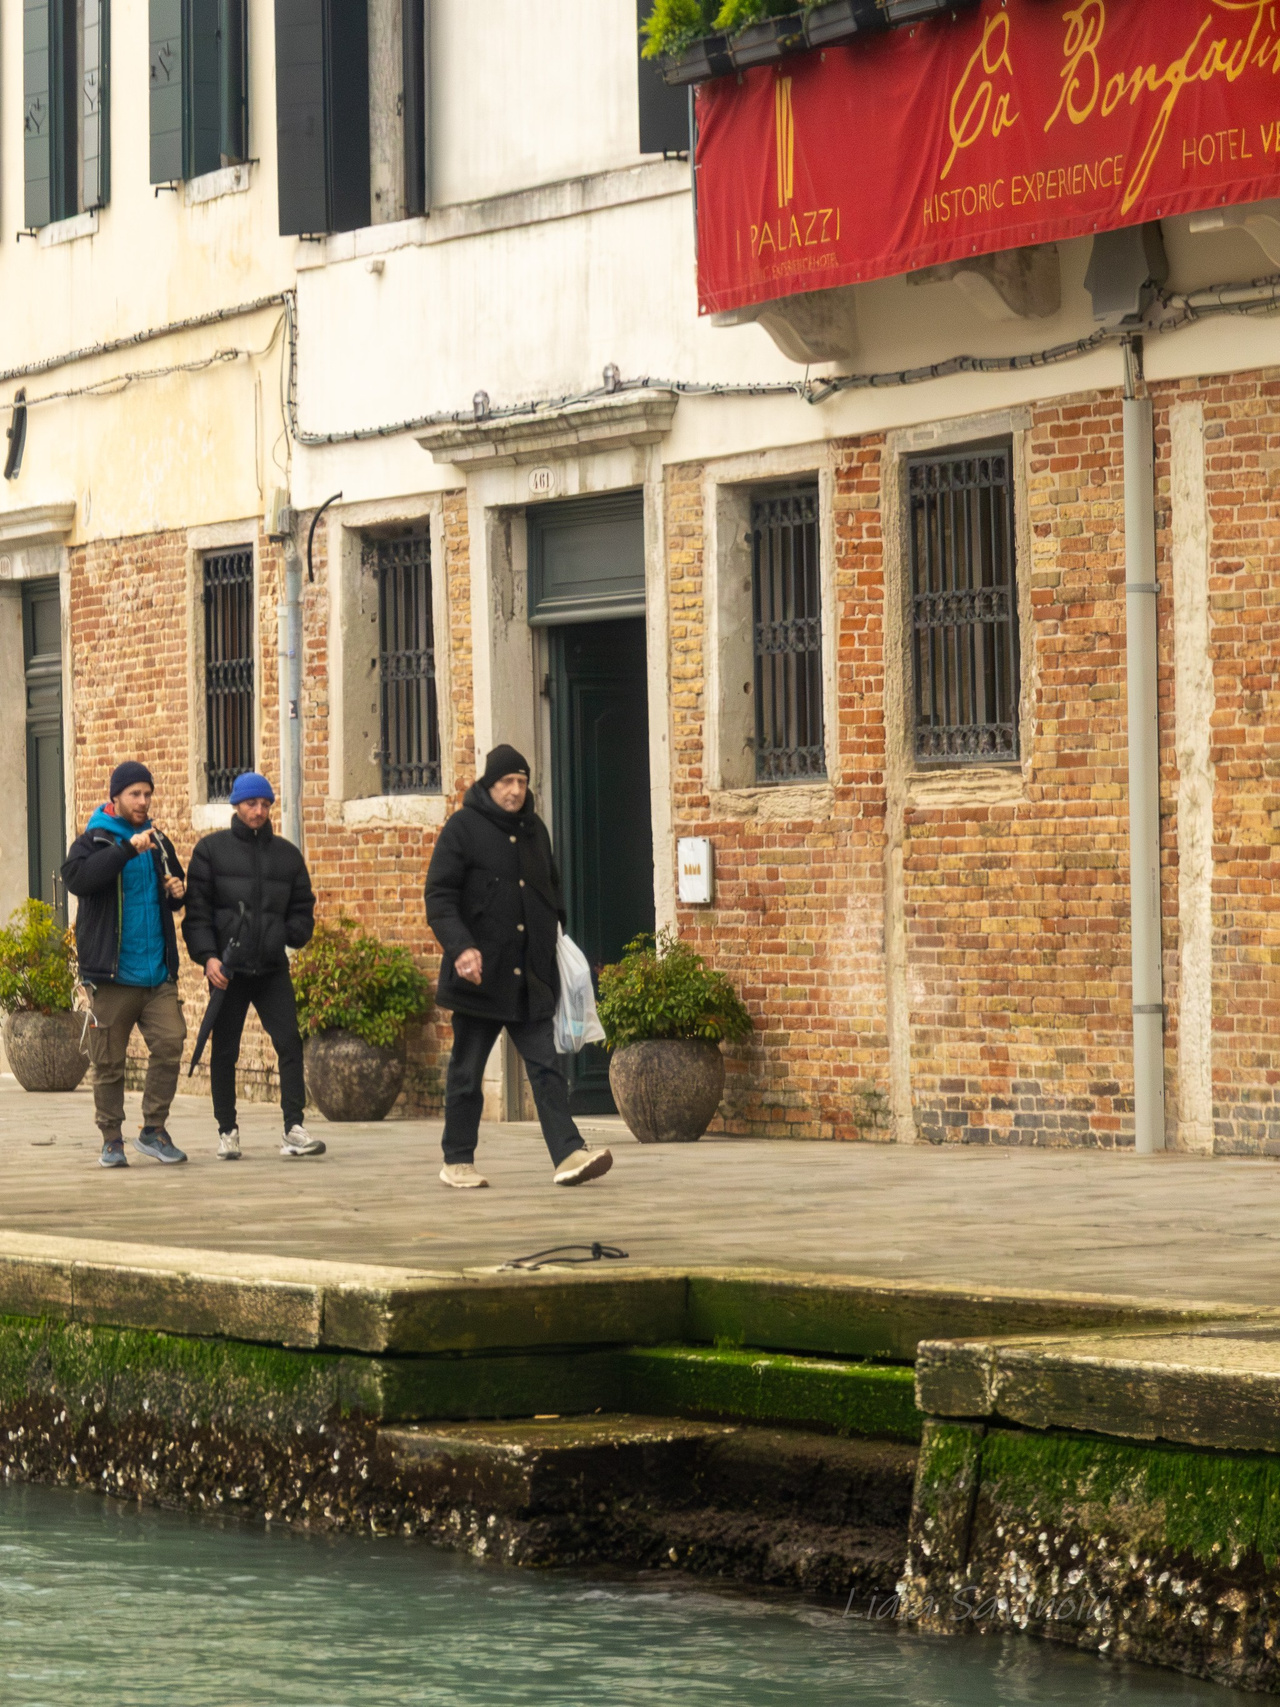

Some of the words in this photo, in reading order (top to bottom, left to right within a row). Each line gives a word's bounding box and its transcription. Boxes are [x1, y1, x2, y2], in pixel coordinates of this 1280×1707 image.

[923, 178, 1005, 226] HISTORIC
[1010, 154, 1124, 206] EXPERIENCE
[1181, 127, 1253, 170] HOTEL
[750, 206, 841, 260] PALAZZI
[534, 471, 550, 490] 461
